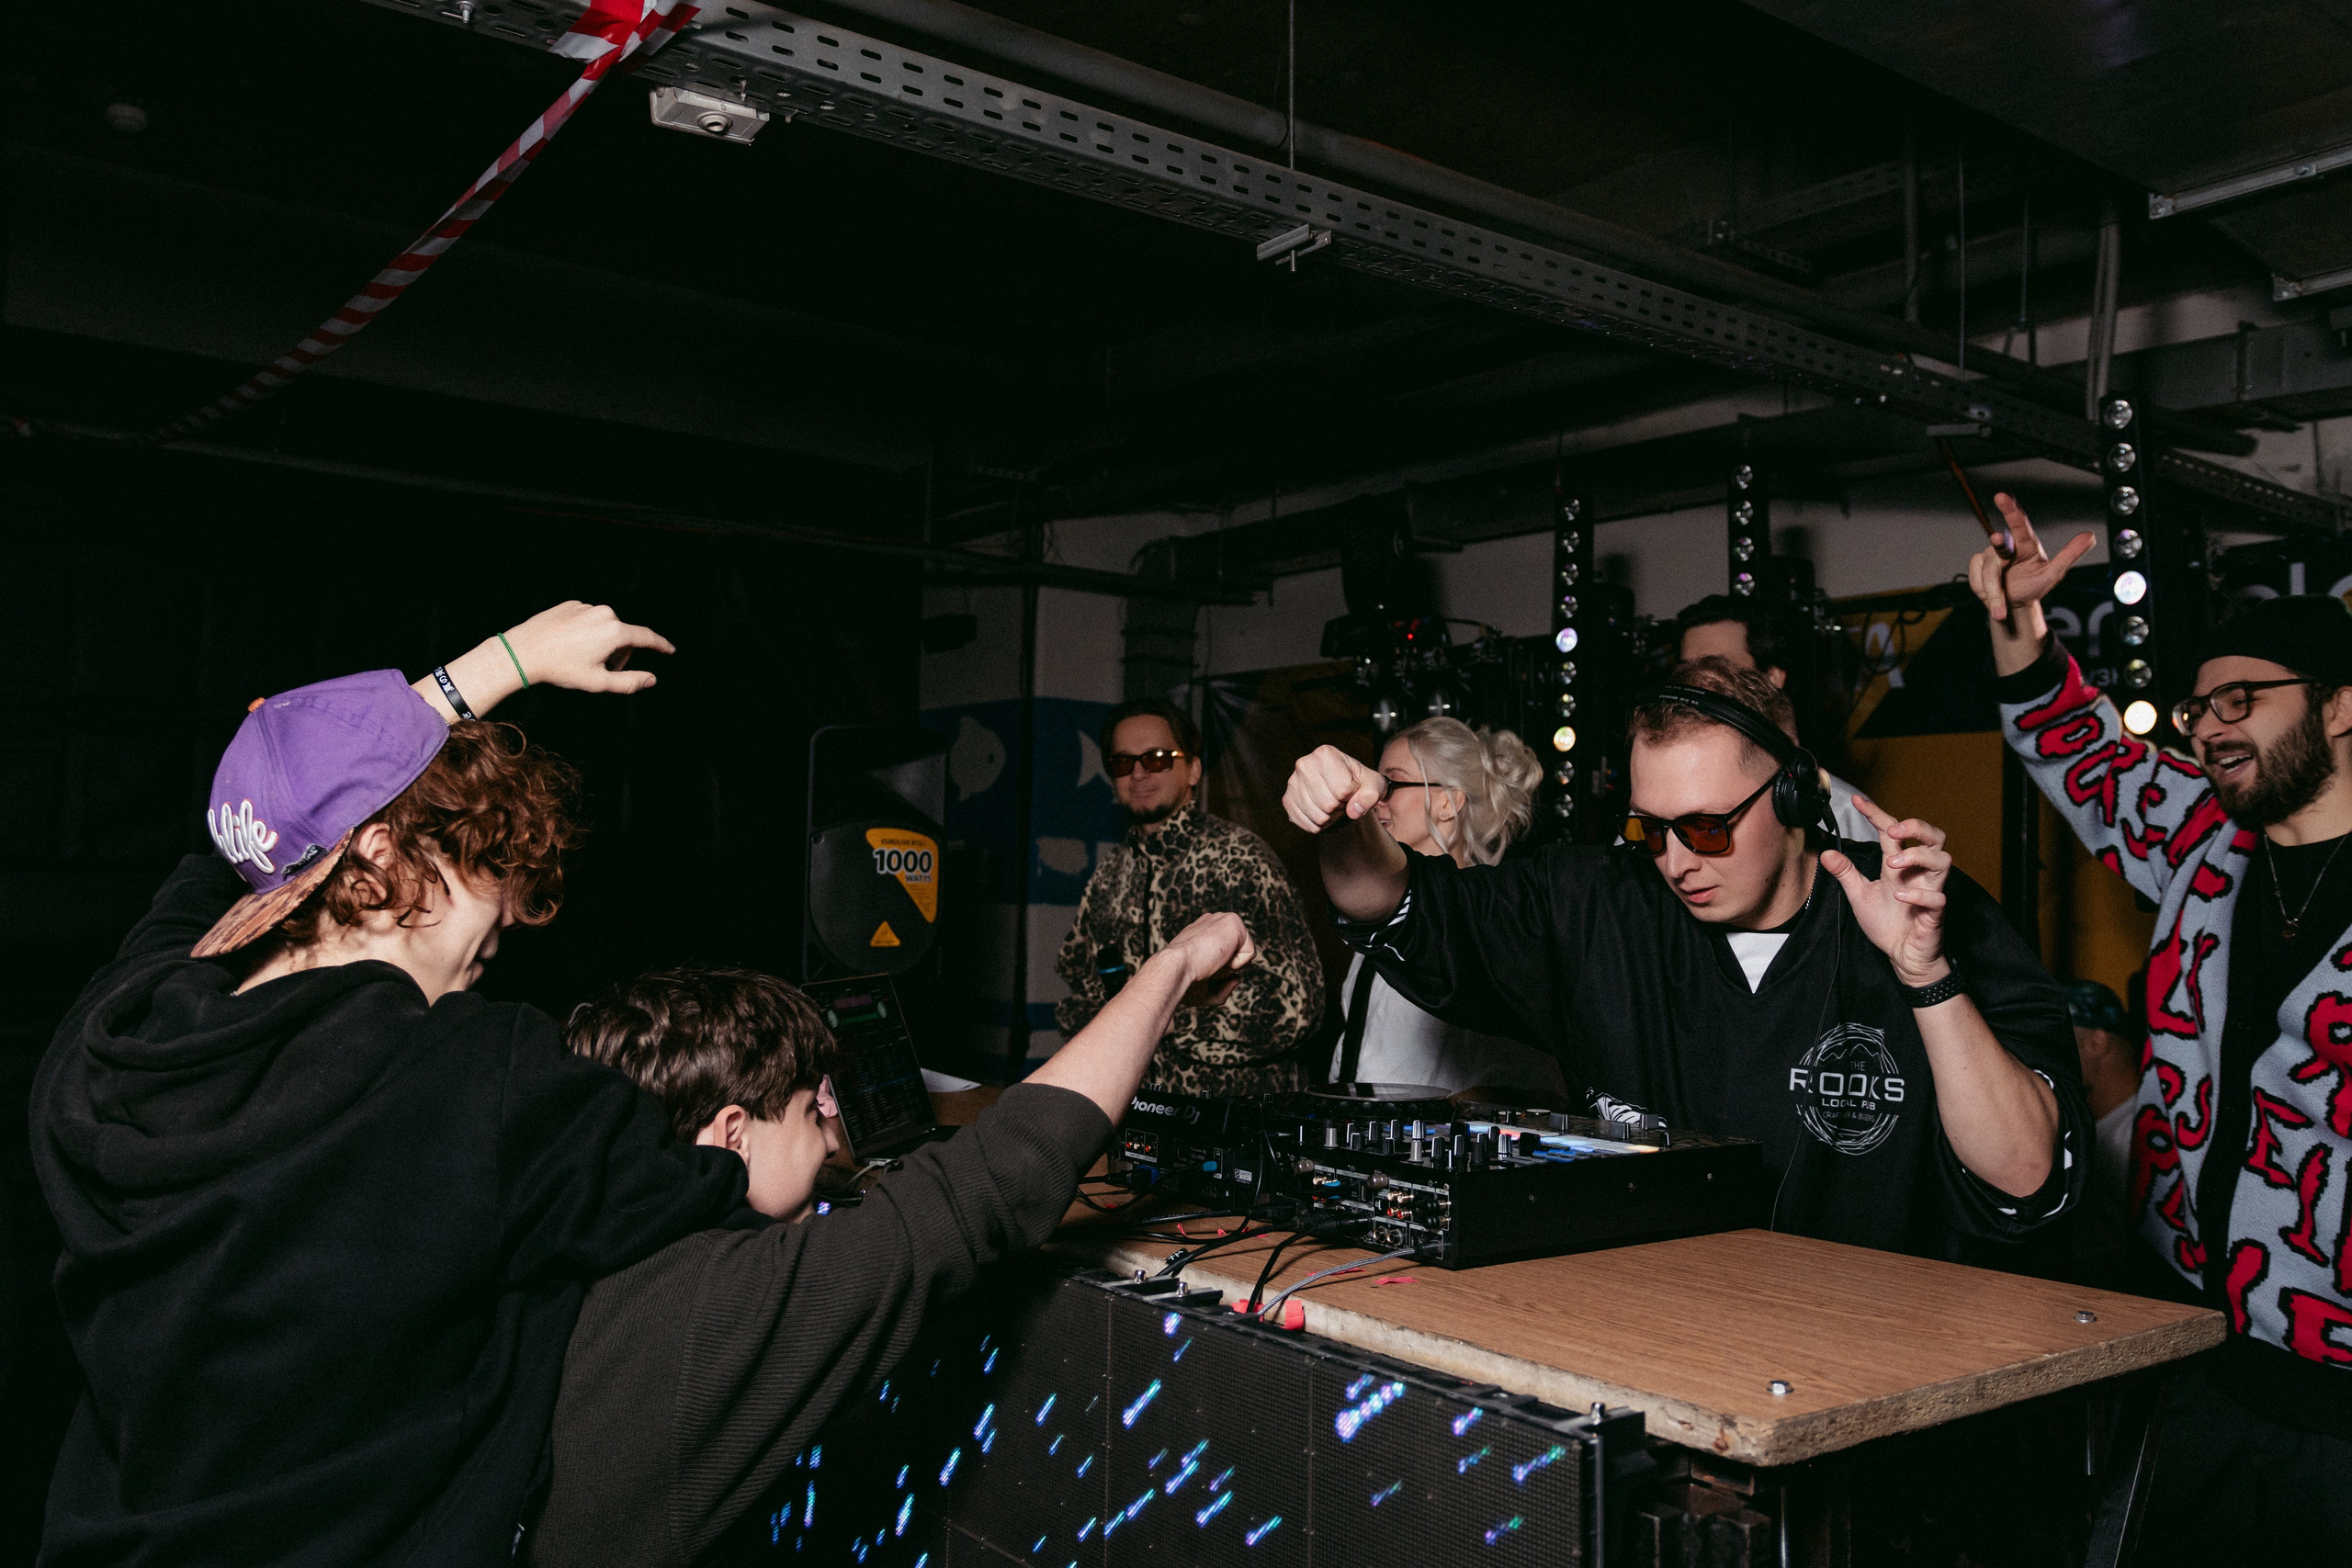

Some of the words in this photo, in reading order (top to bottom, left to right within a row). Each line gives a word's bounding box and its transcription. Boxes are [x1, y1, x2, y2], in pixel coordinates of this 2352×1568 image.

[873, 849, 933, 874] 1000
[1850, 1060, 1866, 1072] THE
[1789, 1067, 1905, 1102] ROOKS
[1821, 1098, 1857, 1108] LOCAL
[1861, 1100, 1876, 1111] PUB
